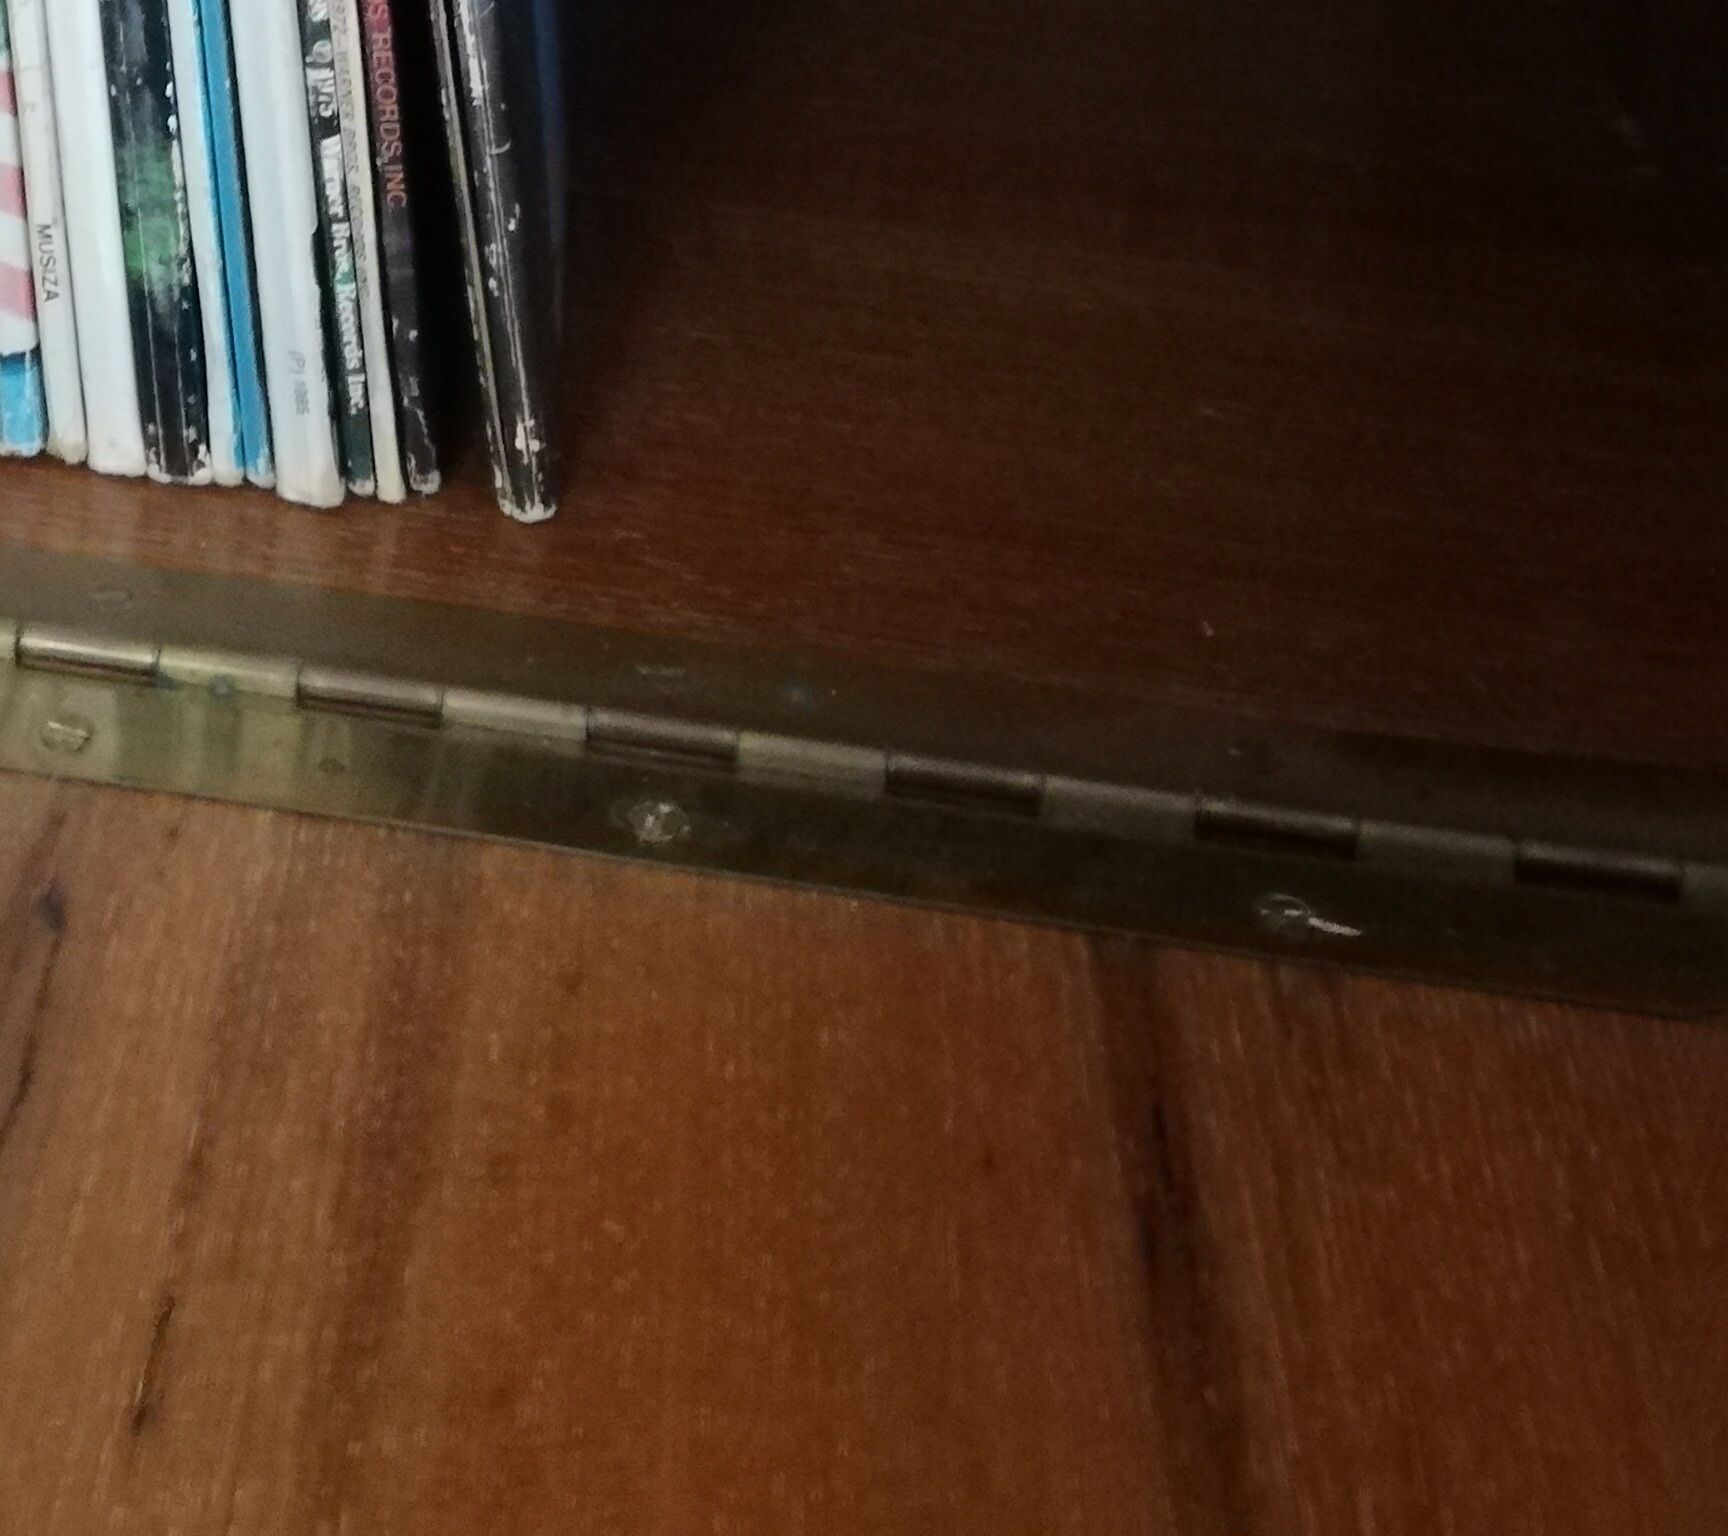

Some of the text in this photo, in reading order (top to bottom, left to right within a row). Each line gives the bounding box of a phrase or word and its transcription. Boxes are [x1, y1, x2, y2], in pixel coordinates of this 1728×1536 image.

[318, 135, 350, 217] Warner
[33, 223, 61, 303] MUSIZA
[333, 282, 365, 371] Records
